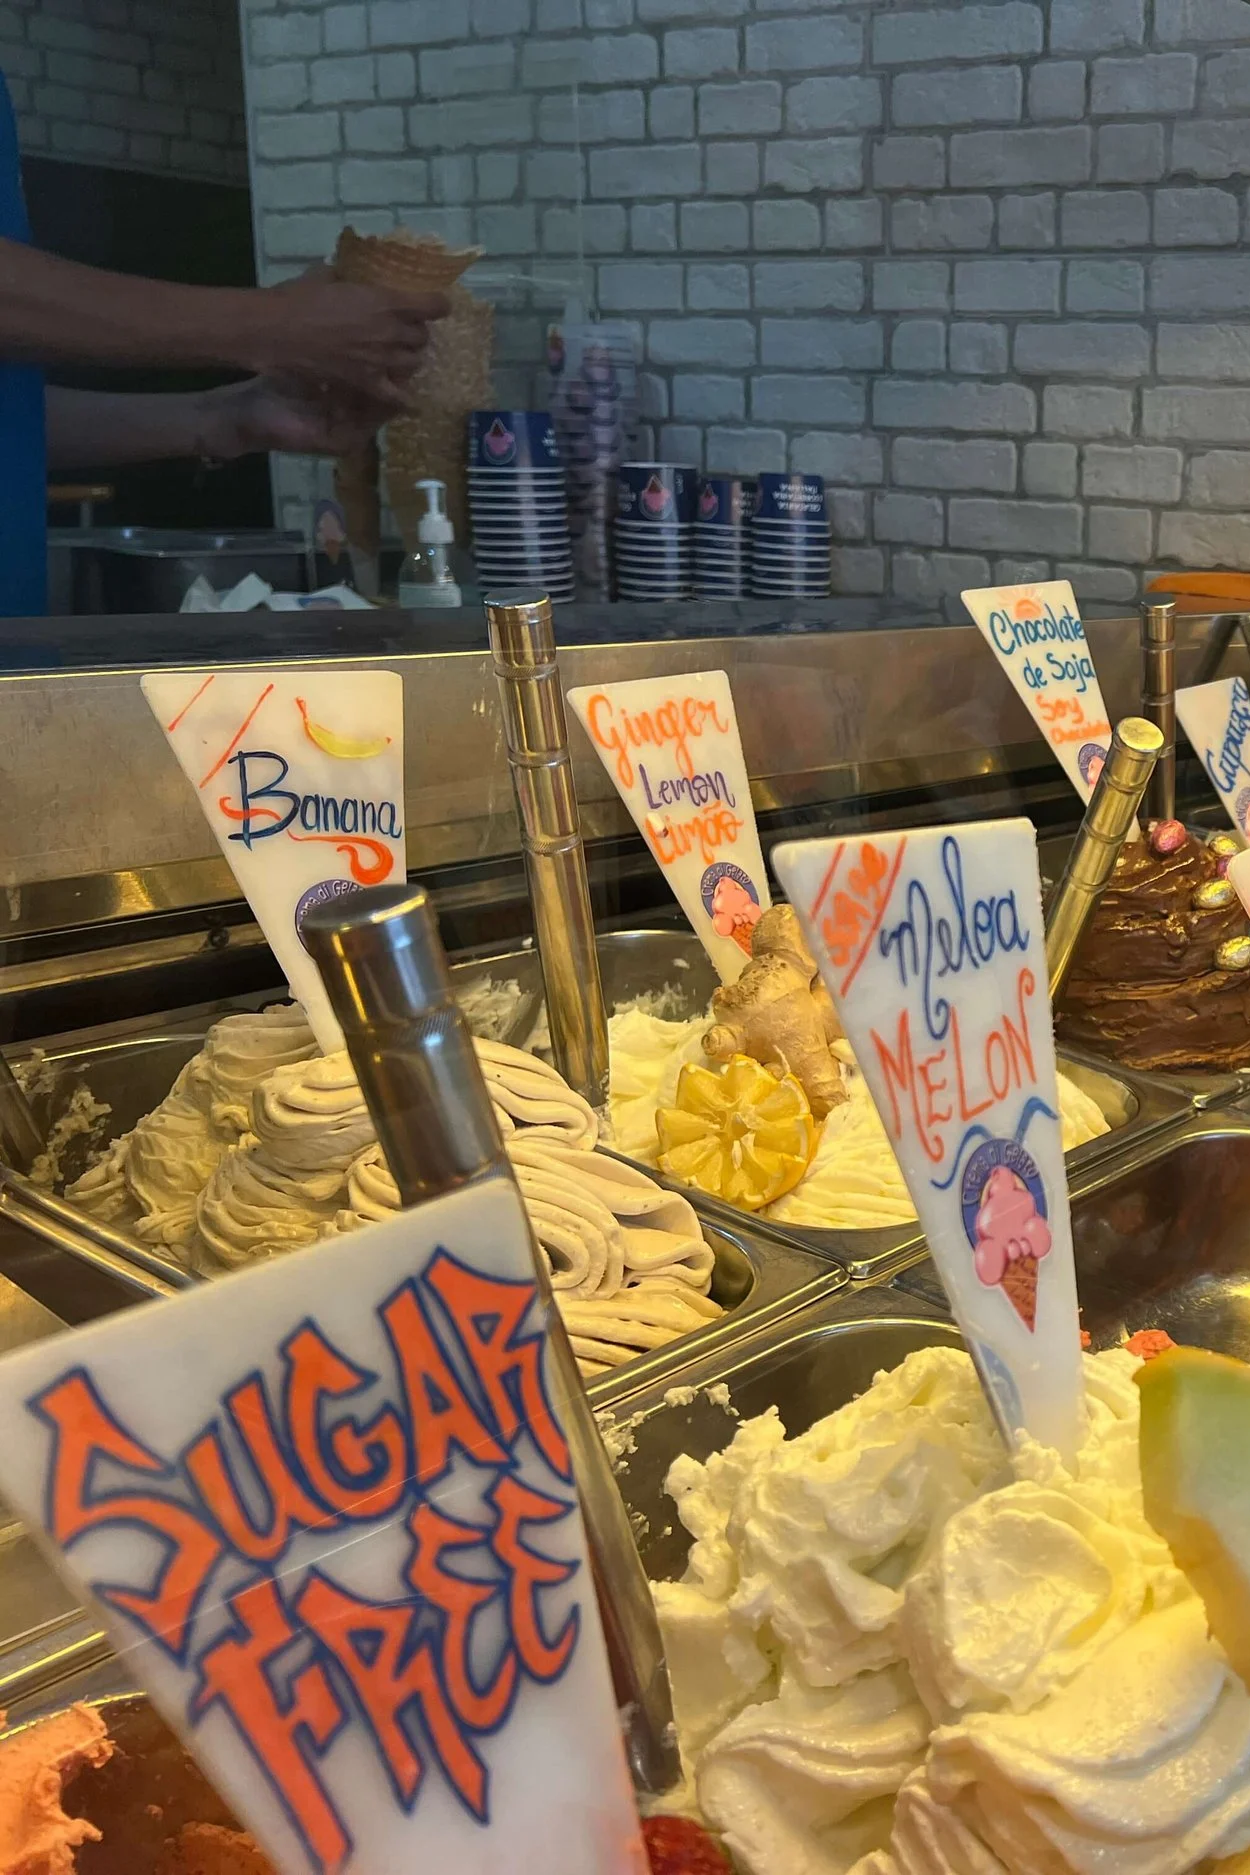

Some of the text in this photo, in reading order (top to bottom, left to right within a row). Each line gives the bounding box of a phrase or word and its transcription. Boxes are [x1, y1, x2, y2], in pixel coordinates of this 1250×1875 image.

[989, 603, 1086, 655] Chocolate
[1023, 653, 1096, 692] de Soja
[1035, 693, 1084, 724] Soy
[587, 693, 729, 789] Ginger
[228, 750, 402, 851] Banana
[639, 763, 736, 809] Lemon
[317, 883, 331, 900] di
[869, 967, 1037, 1163] MELON
[25, 1244, 576, 1670] SUGAR
[187, 1478, 583, 1875] FREE
